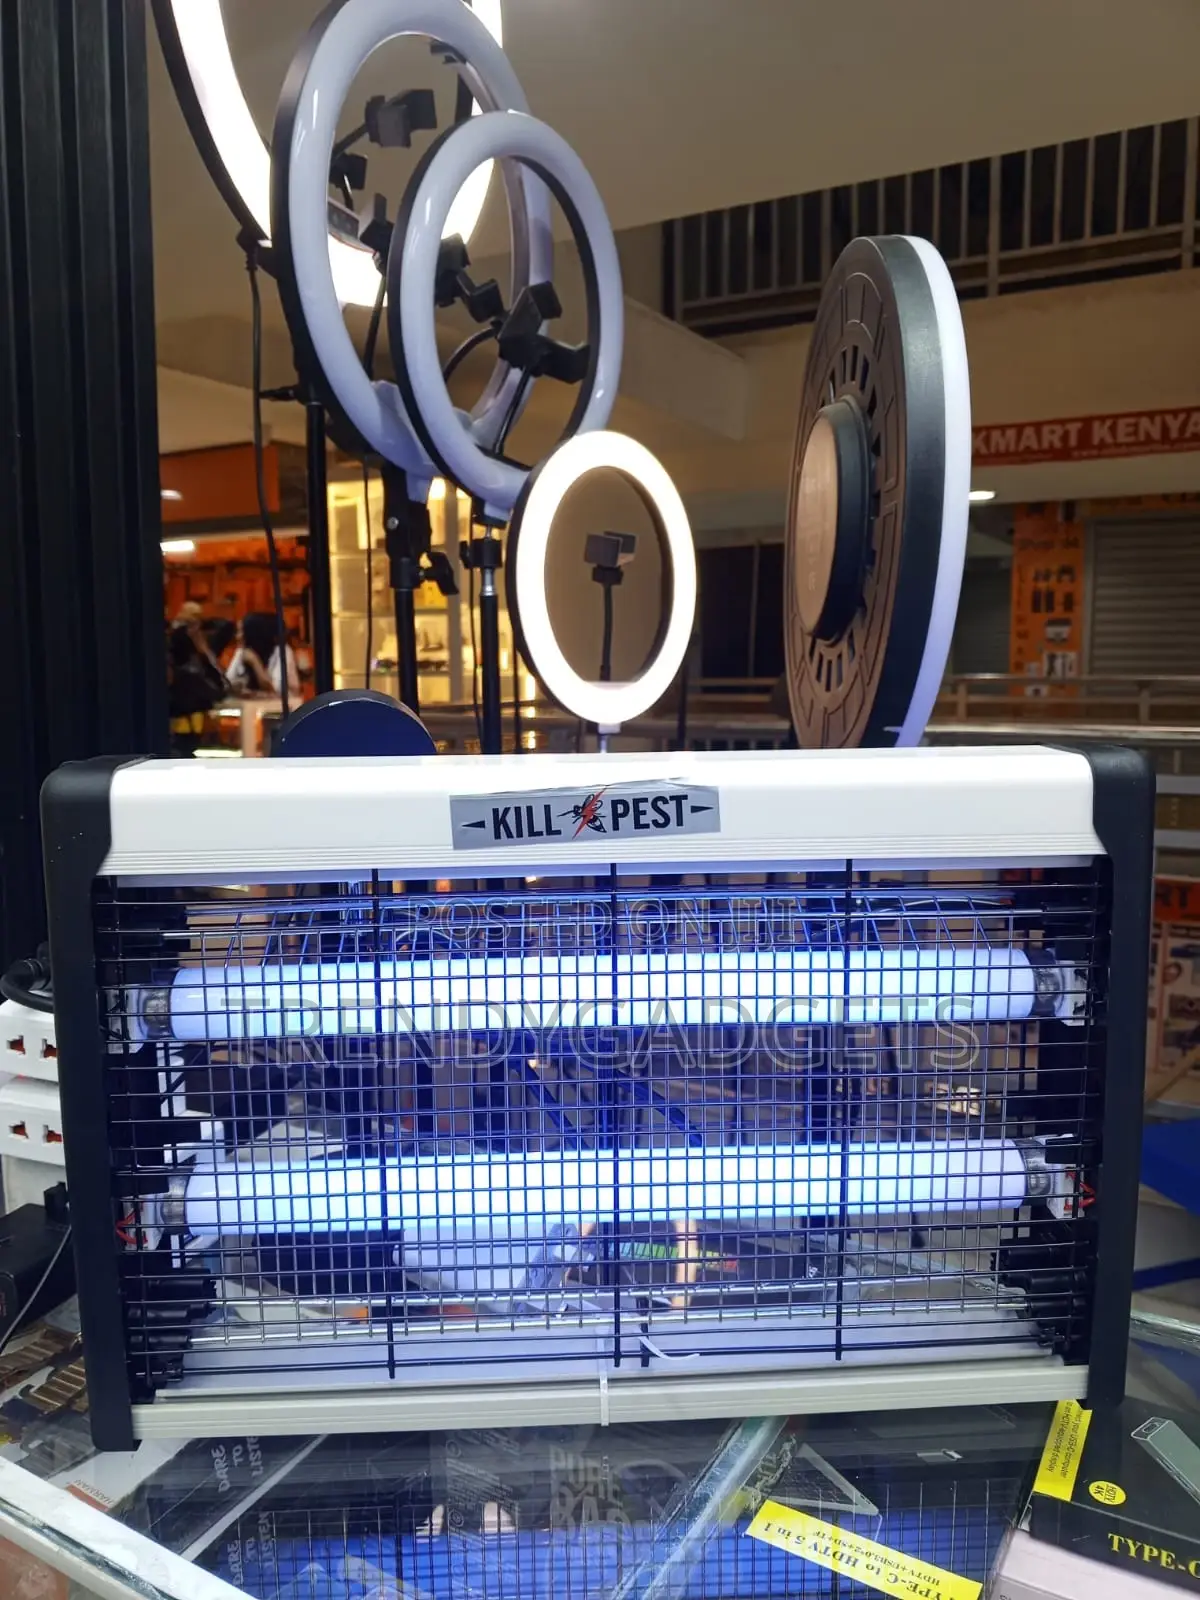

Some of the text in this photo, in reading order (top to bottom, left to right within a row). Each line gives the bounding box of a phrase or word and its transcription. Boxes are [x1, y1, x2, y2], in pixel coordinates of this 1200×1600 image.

[1092, 411, 1200, 446] KENYA
[491, 794, 688, 840] KILL PEST
[211, 1445, 230, 1493] DARE
[232, 1445, 243, 1466] TO
[247, 1436, 264, 1477] LISTE
[777, 1525, 791, 1540] in
[794, 1534, 806, 1545] 5
[807, 1543, 860, 1568] HDTV
[865, 1563, 881, 1575] to
[1108, 1533, 1200, 1579] TYPE-C
[886, 1572, 956, 1600] YPE-C
